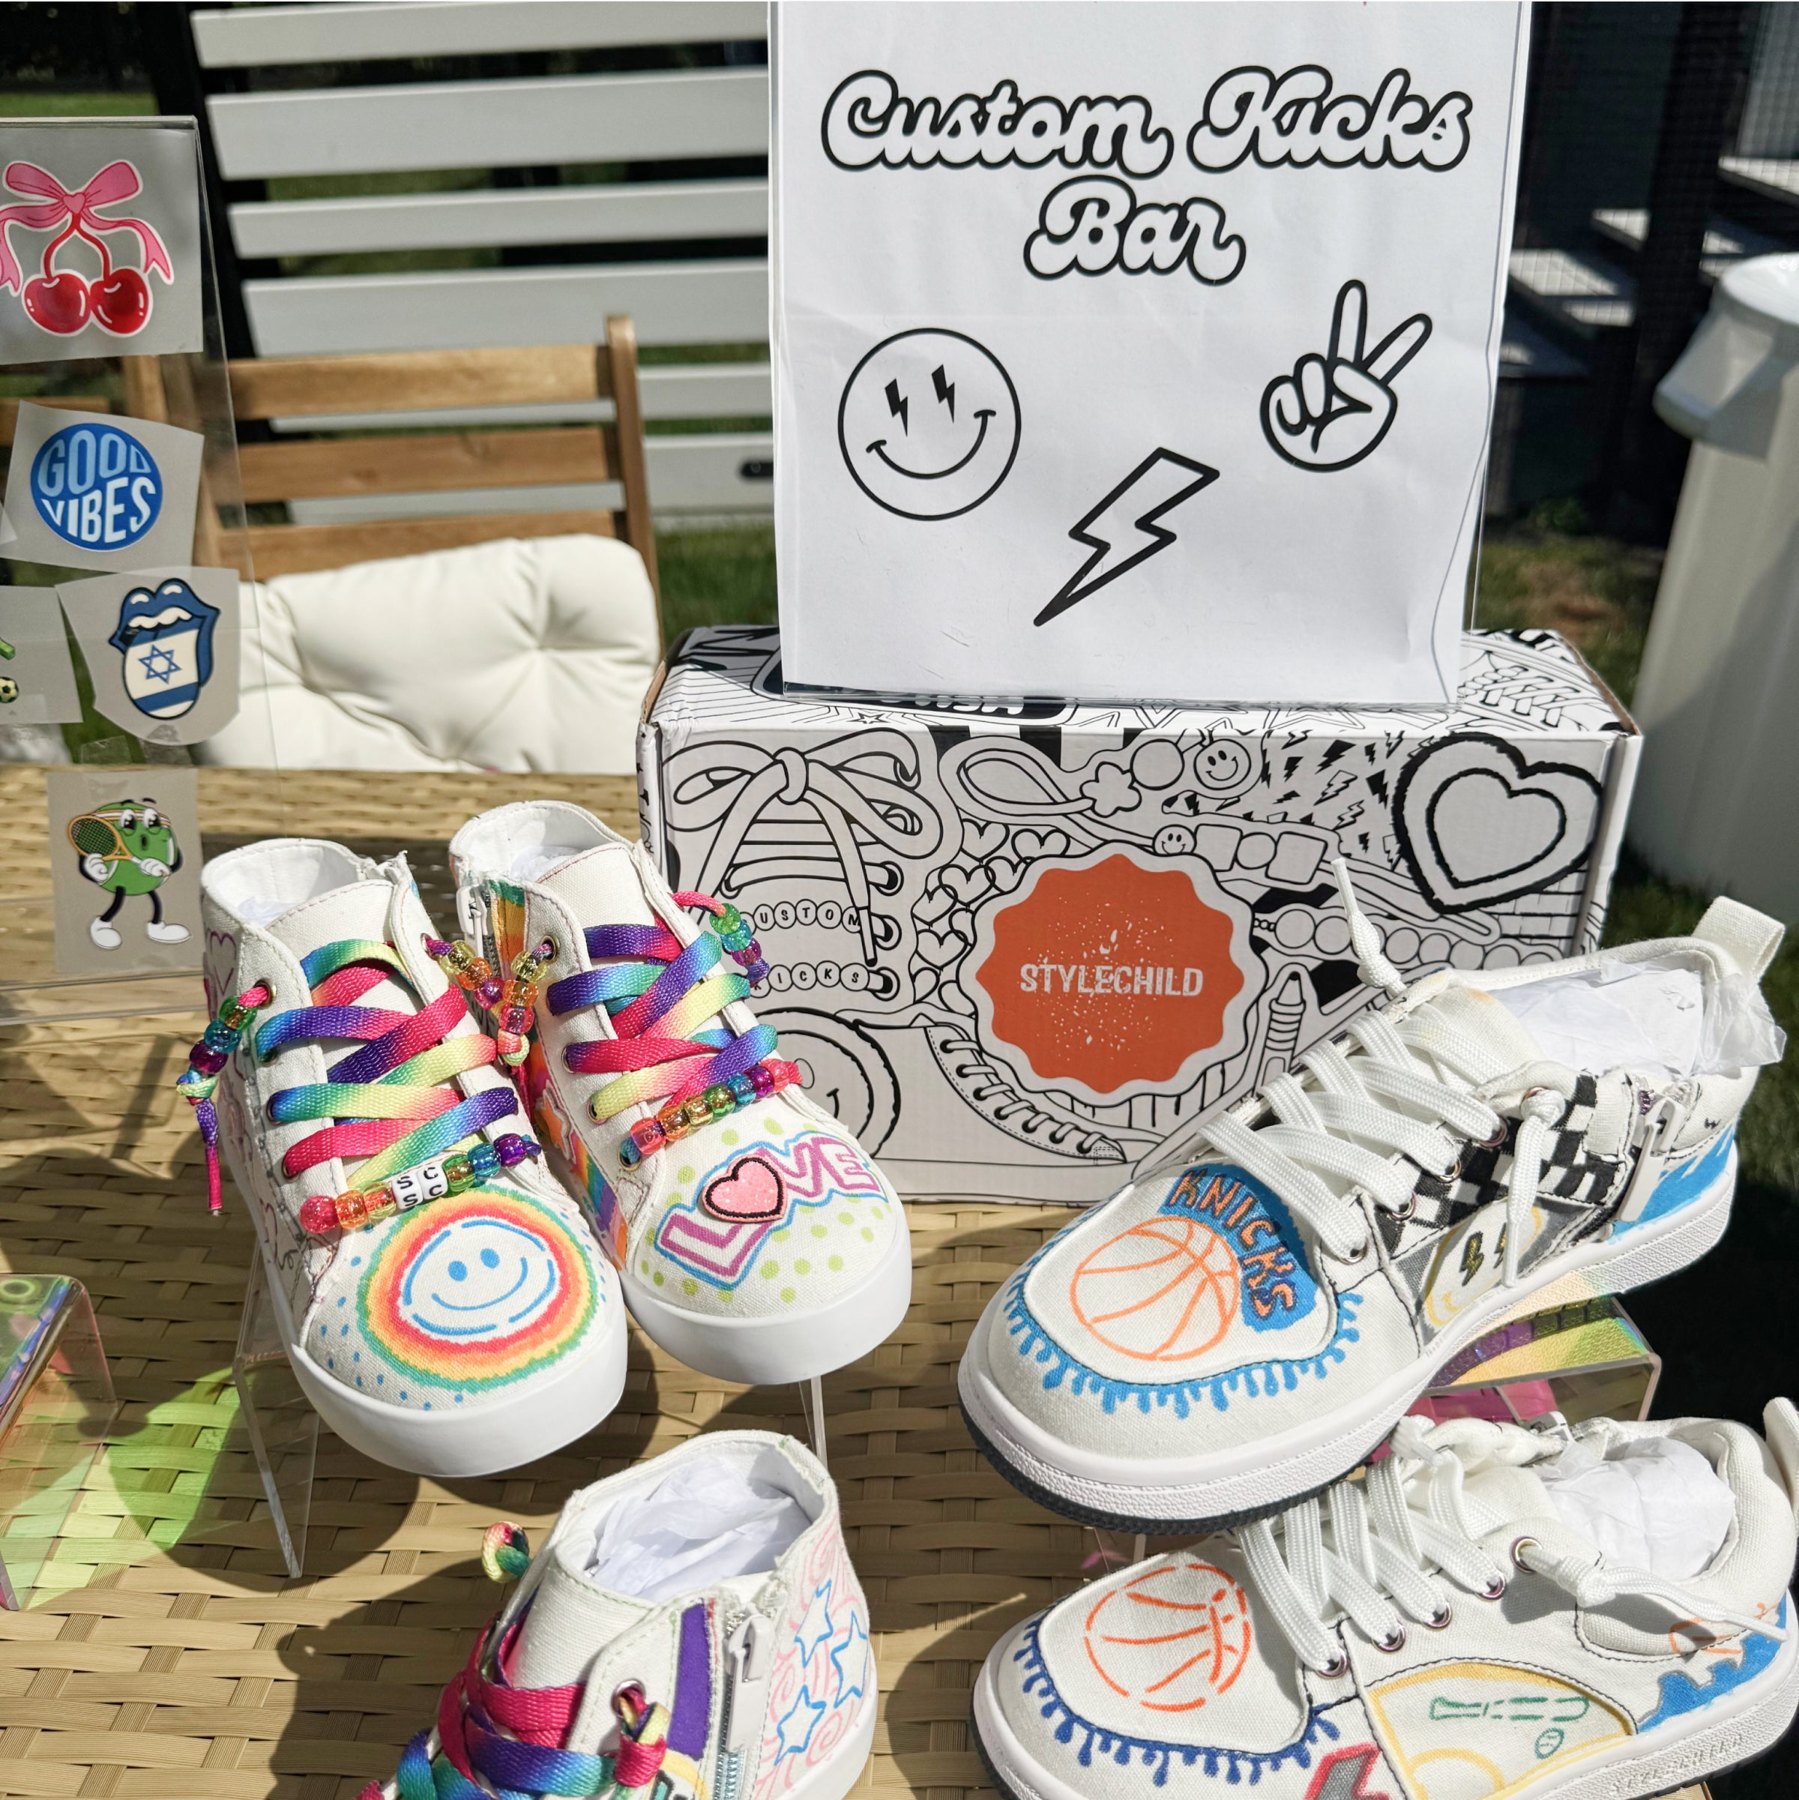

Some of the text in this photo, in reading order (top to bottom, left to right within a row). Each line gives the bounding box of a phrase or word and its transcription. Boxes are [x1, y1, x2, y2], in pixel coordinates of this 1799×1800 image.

[821, 64, 1472, 179] Custom Kicks
[1023, 175, 1246, 286] Bar
[37, 429, 152, 497] GOOD
[40, 476, 156, 543] VIBES
[757, 905, 861, 926] USTOM
[1020, 957, 1204, 997] STYLECHILD
[657, 1133, 884, 1282] LVE
[1167, 1168, 1297, 1320] KNICKS
